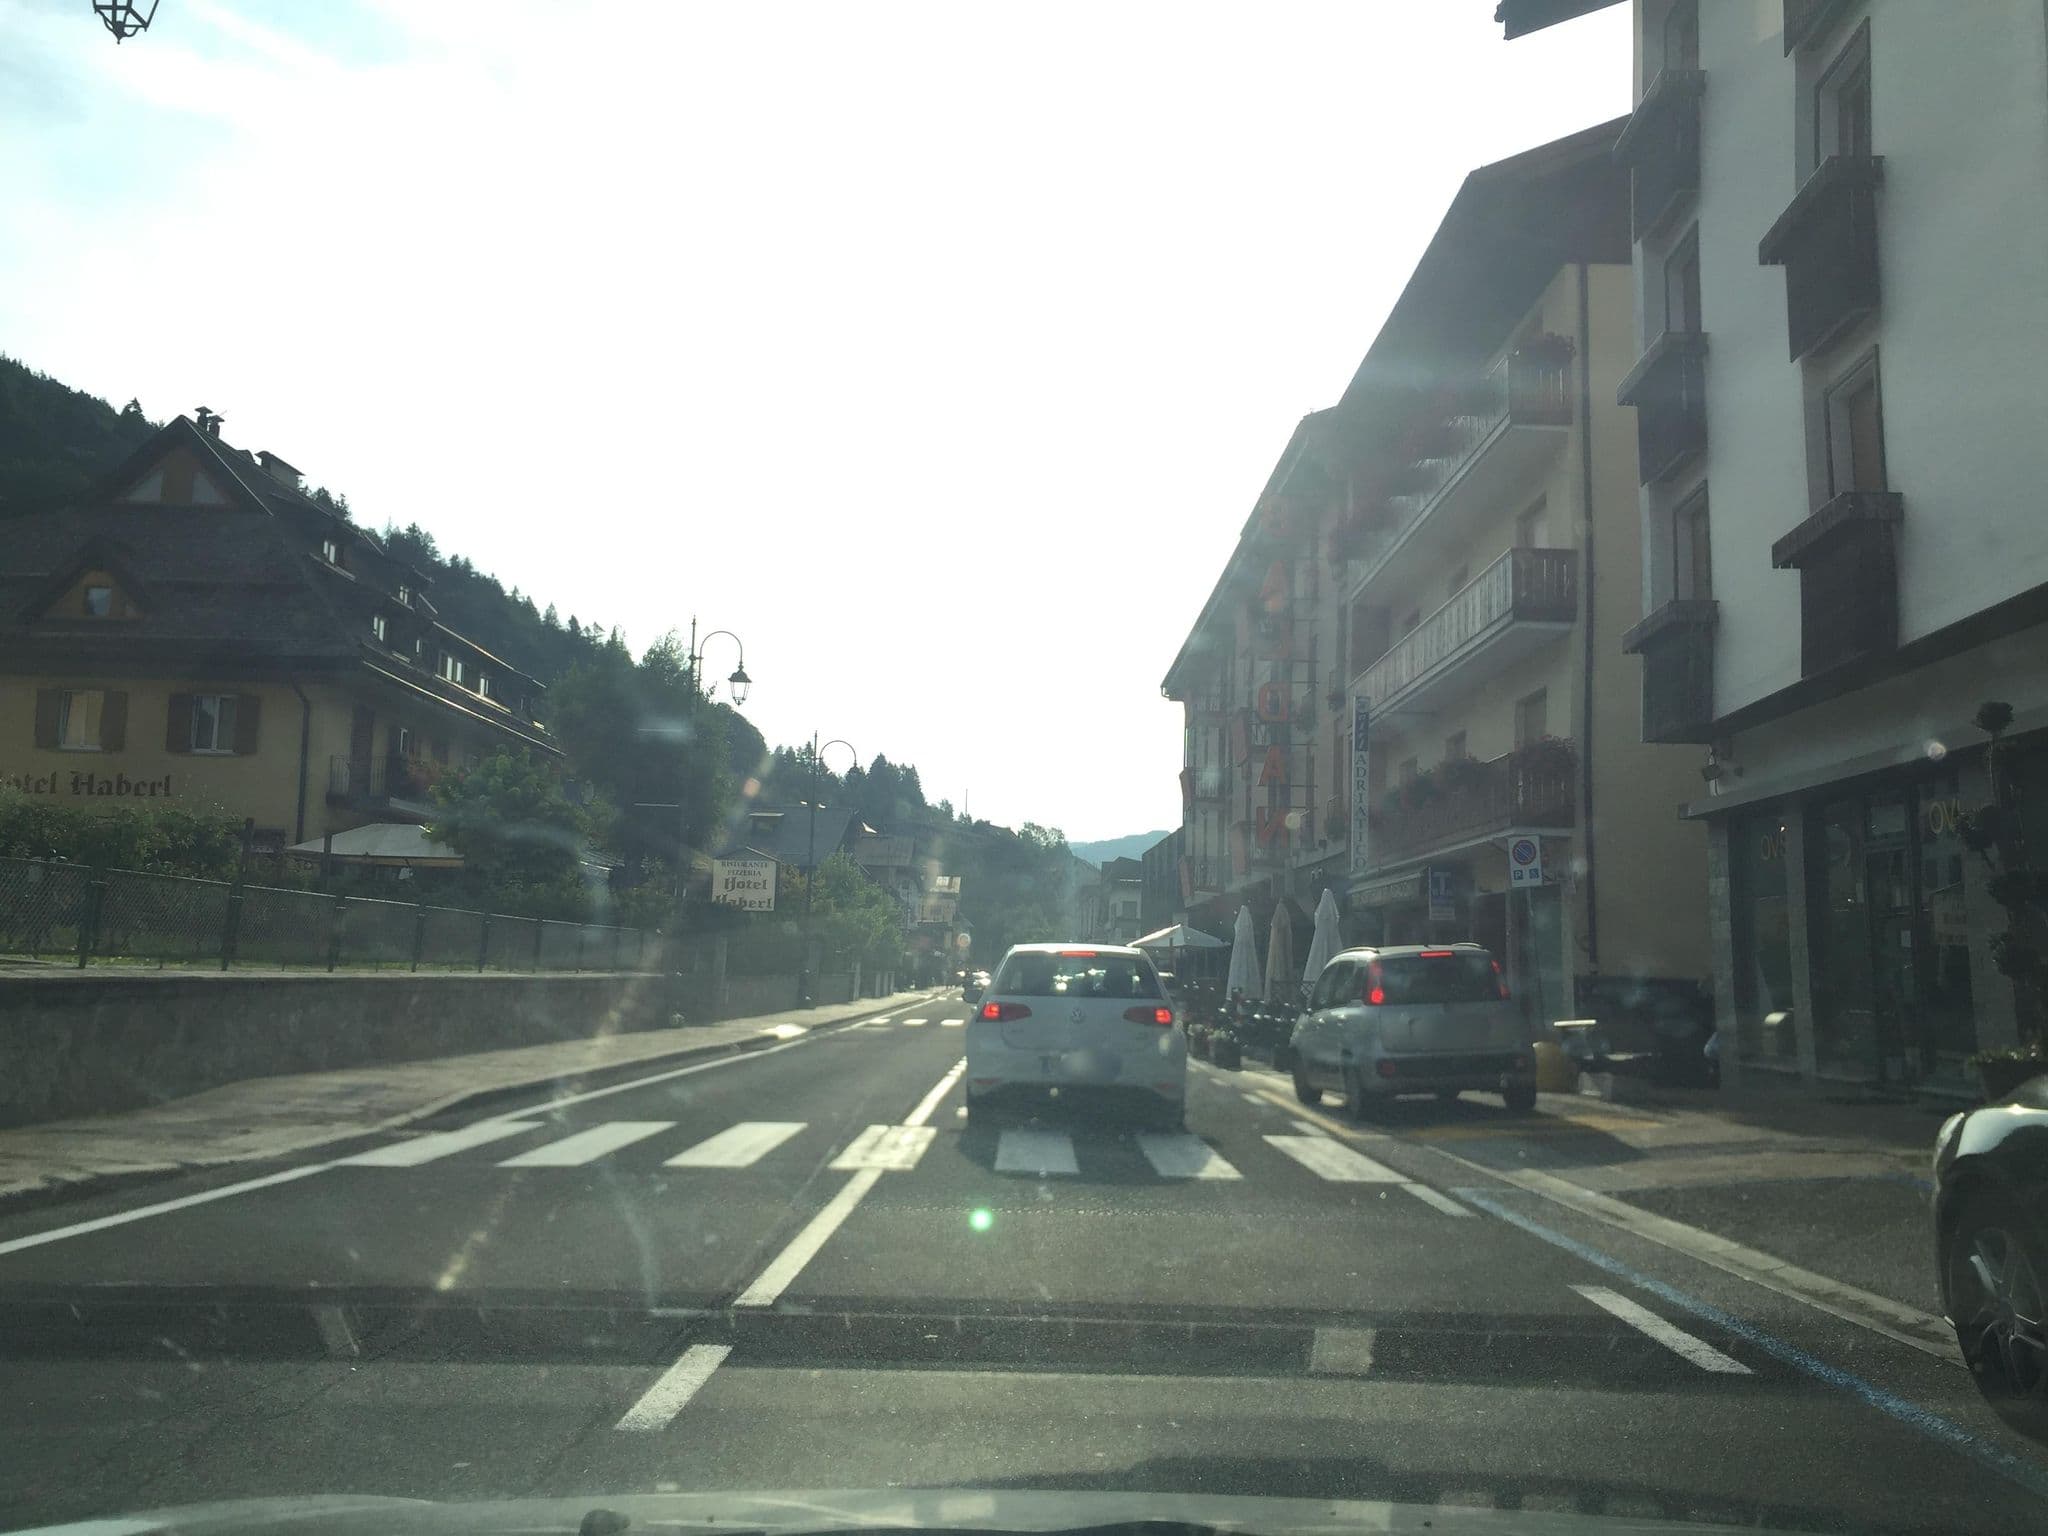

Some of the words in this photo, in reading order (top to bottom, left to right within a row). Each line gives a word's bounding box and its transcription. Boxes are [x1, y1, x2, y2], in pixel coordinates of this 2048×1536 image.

[70, 770, 171, 797] Haberl
[1354, 754, 1368, 868] ADRIATICO
[724, 877, 767, 892] Hotel
